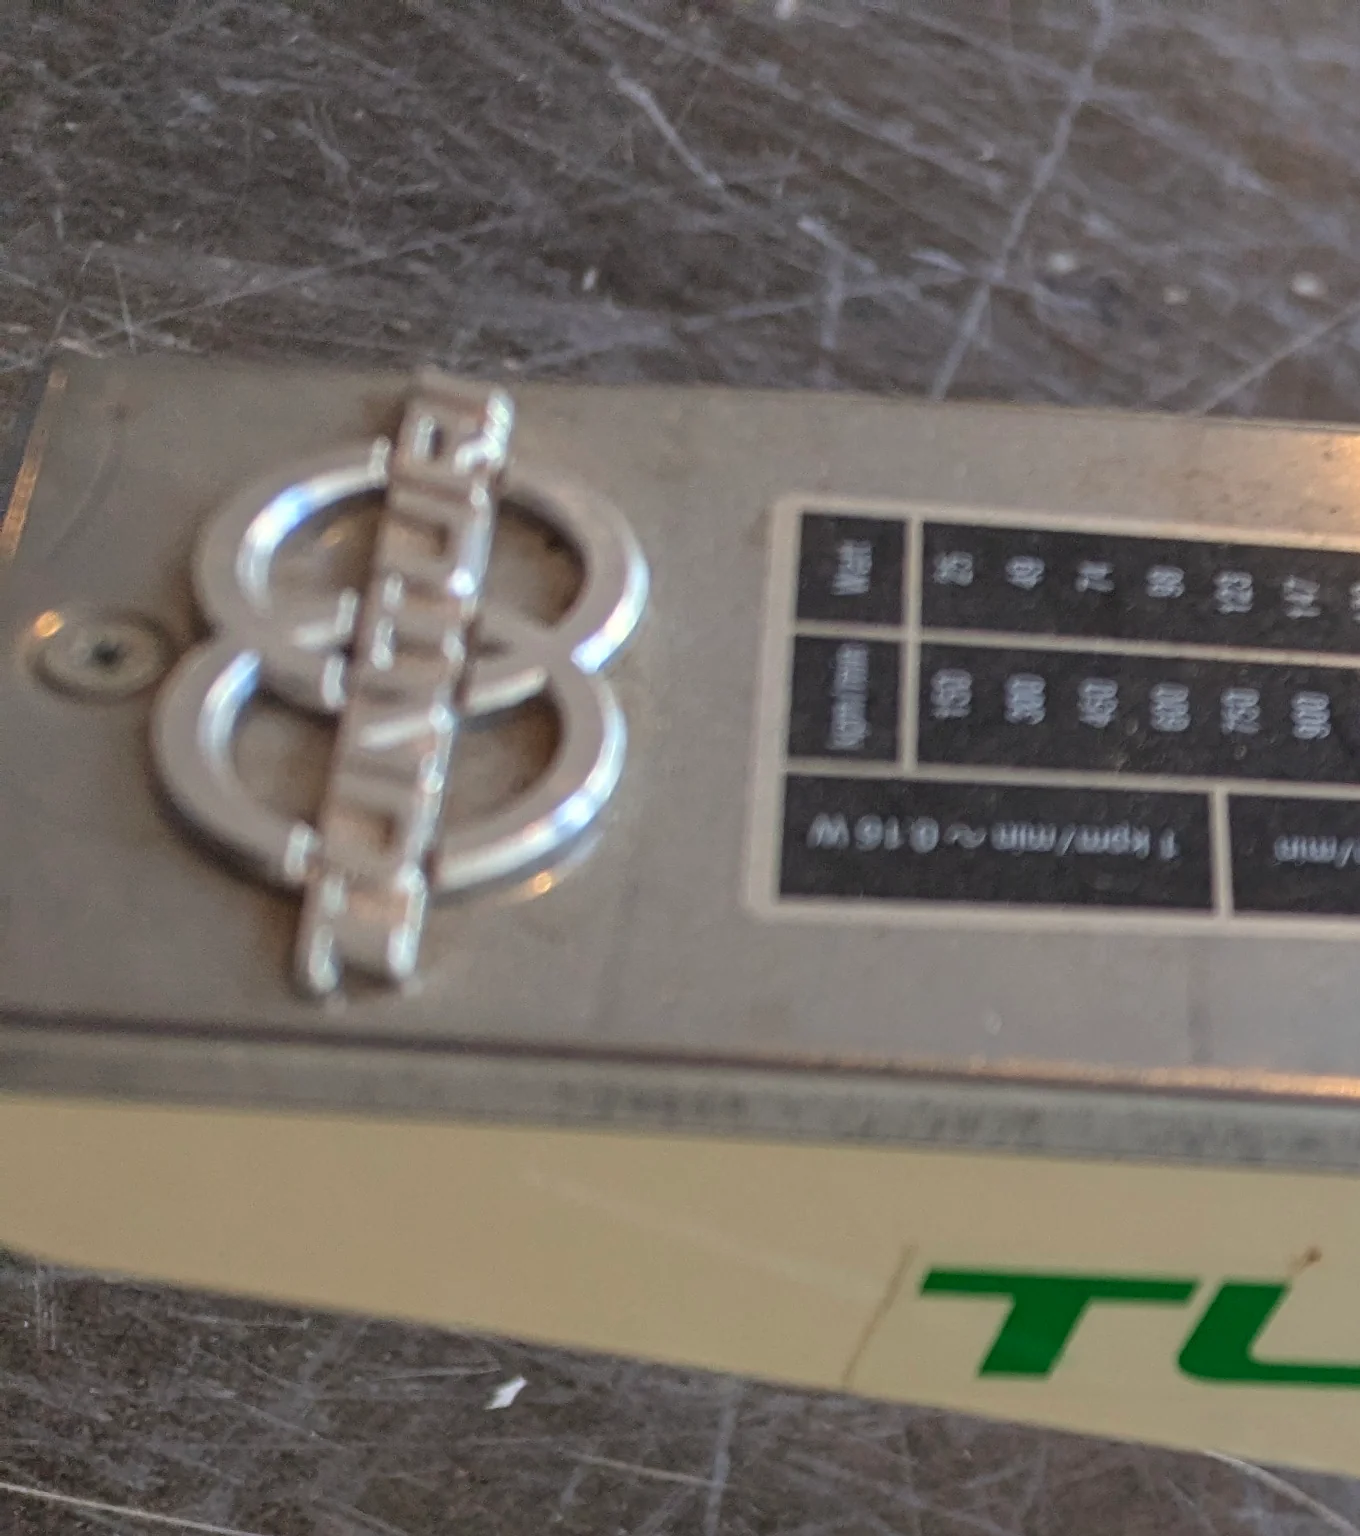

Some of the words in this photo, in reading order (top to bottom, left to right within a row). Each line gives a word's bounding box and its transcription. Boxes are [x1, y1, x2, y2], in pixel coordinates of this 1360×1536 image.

[1282, 574, 1321, 619] 147
[931, 668, 973, 720] 150
[1004, 672, 1046, 726] 300
[1291, 691, 1331, 740] 900
[806, 811, 850, 850] W
[1157, 827, 1180, 861] 1
